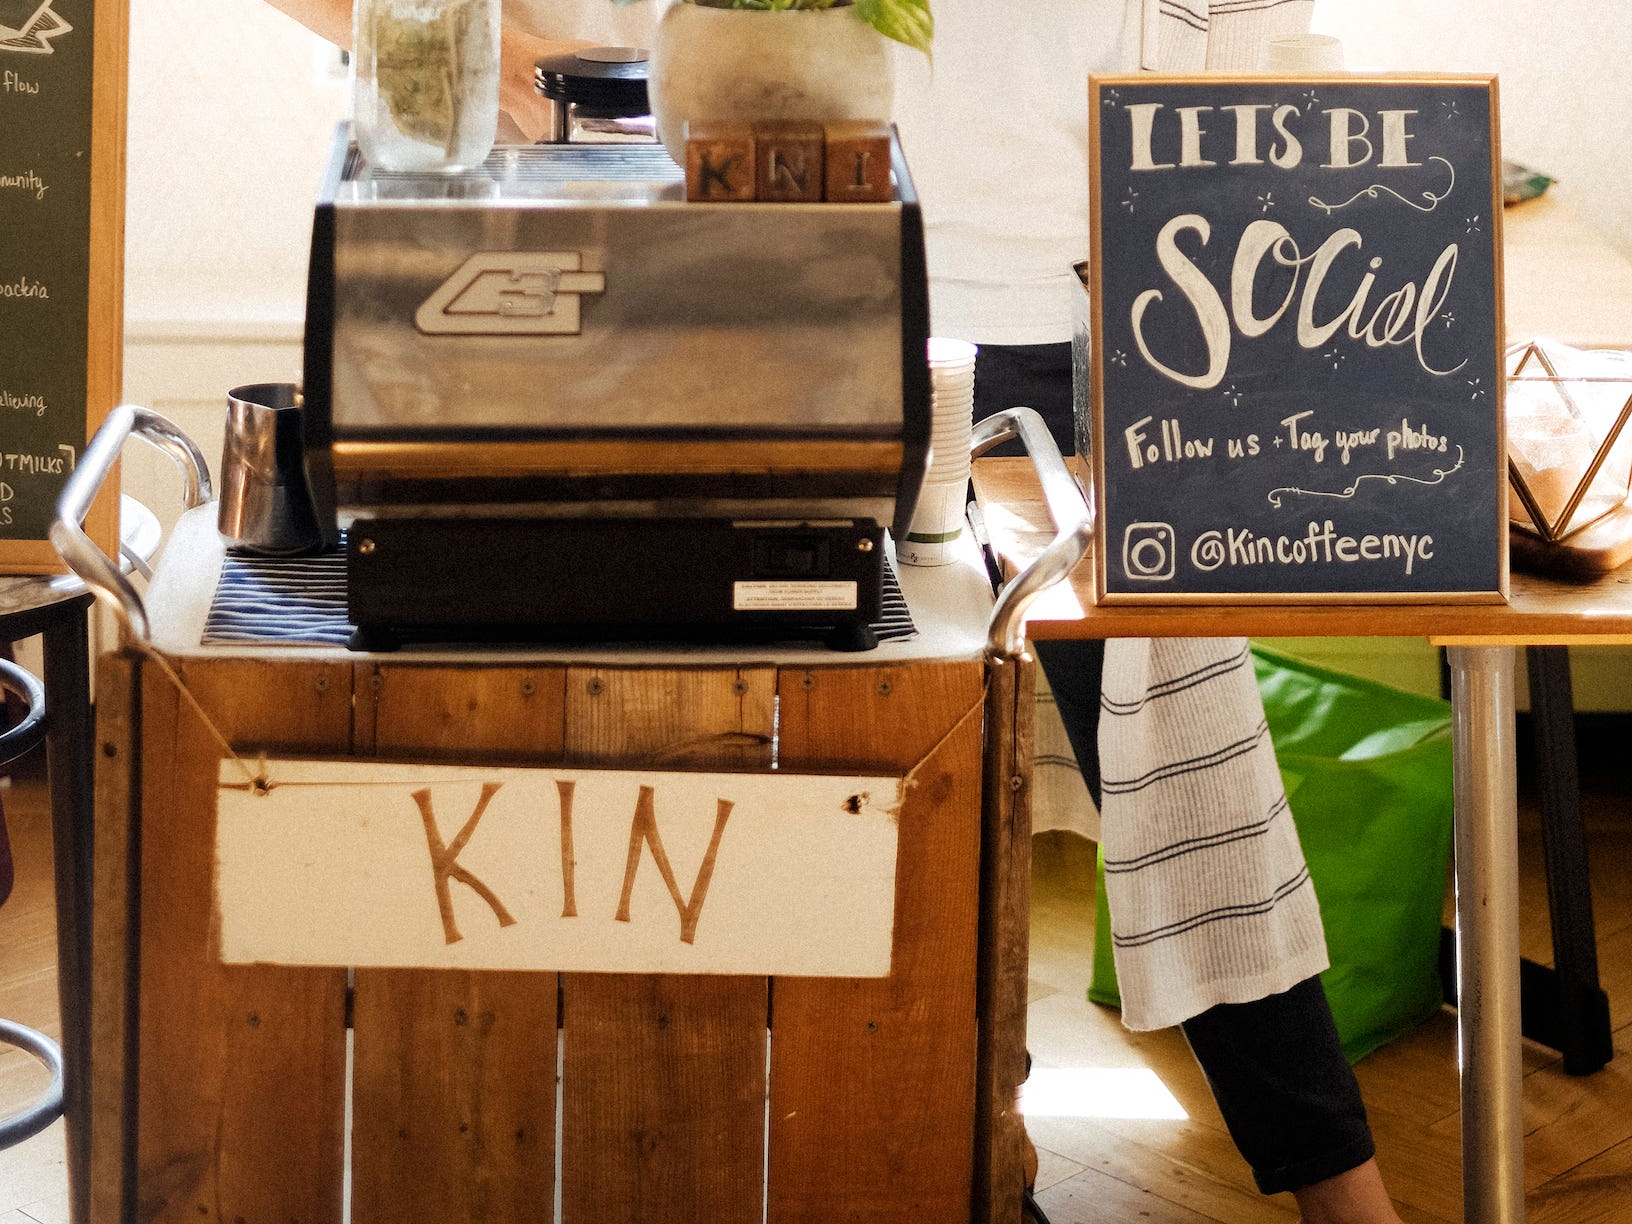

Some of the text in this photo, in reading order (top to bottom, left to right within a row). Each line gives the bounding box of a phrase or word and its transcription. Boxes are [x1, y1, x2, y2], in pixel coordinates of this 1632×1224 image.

[2, 70, 40, 94] flow
[1319, 107, 1424, 170] BE
[1124, 415, 1214, 469] Follow
[1227, 434, 1261, 459] us
[1280, 409, 1330, 463] Tag
[1335, 427, 1381, 465] your
[1386, 417, 1448, 460] photos
[1190, 519, 1434, 576] @Kincoffeenyc
[410, 779, 735, 946] KIN
